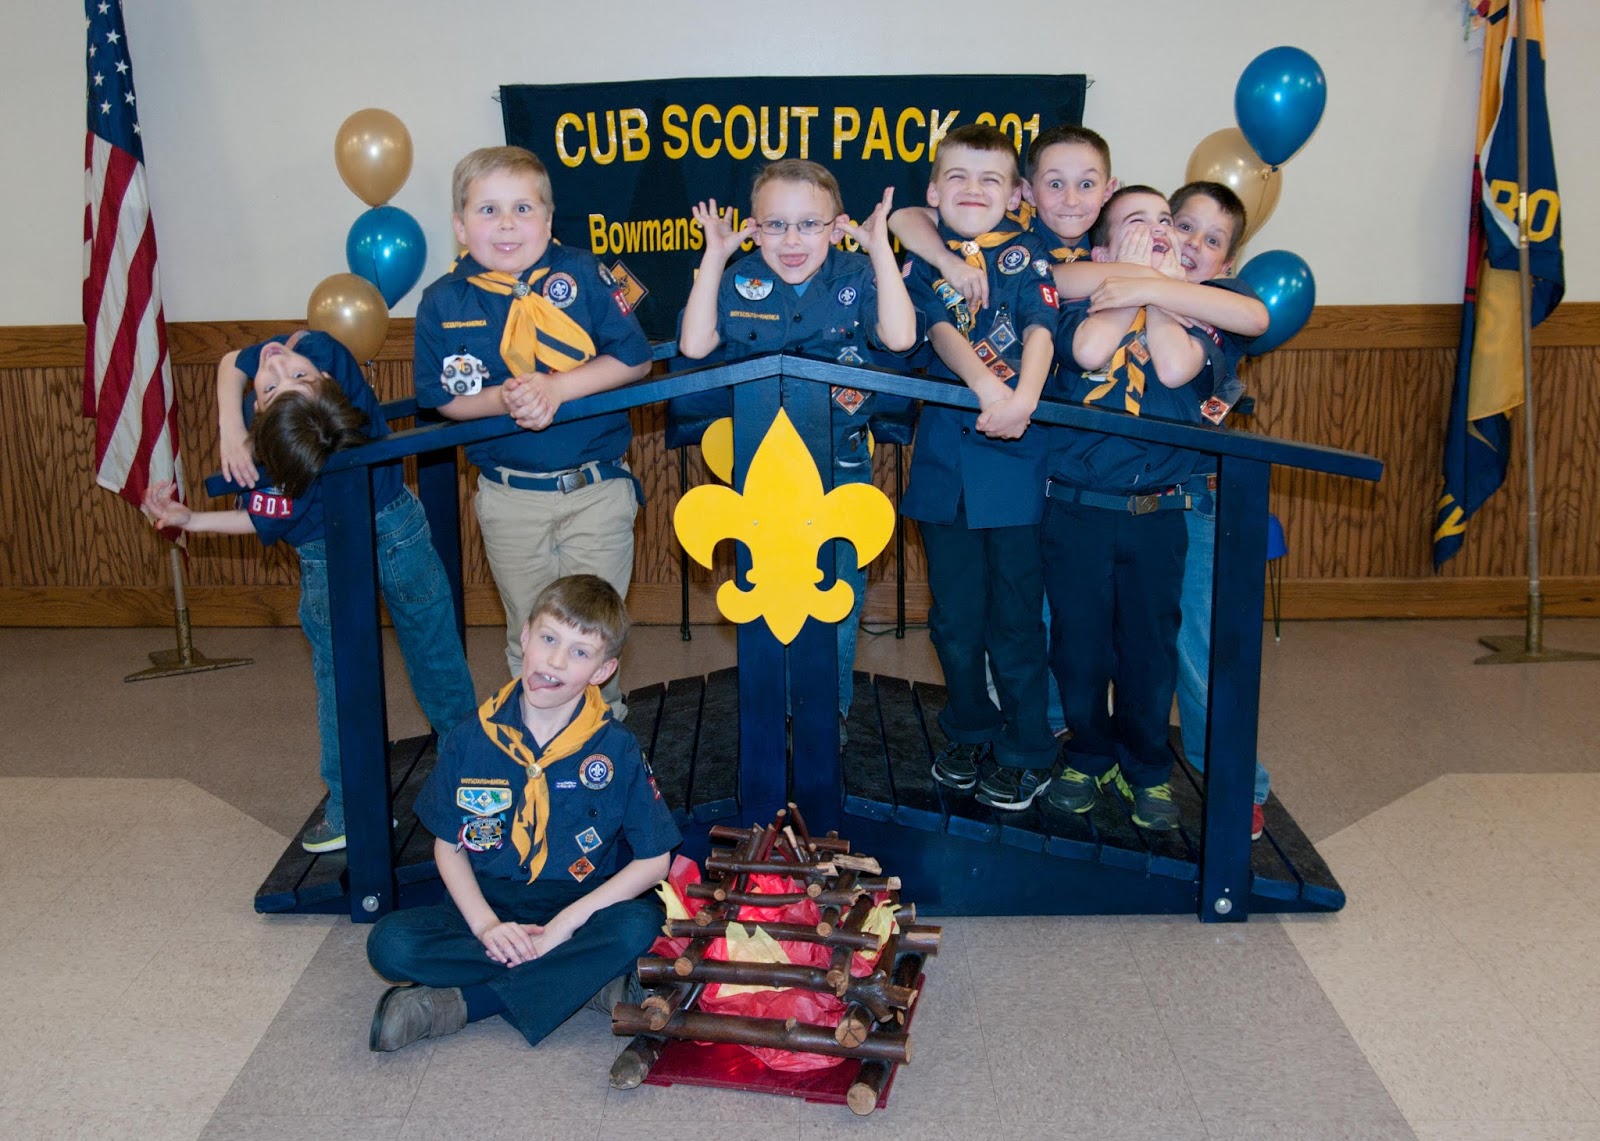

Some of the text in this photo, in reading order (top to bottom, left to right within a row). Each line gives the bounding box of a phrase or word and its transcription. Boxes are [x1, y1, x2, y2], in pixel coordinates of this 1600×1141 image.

[555, 103, 1040, 168] CUB SCOUT PACK 01
[588, 206, 754, 255] Bowmansle
[252, 494, 290, 515] 601
